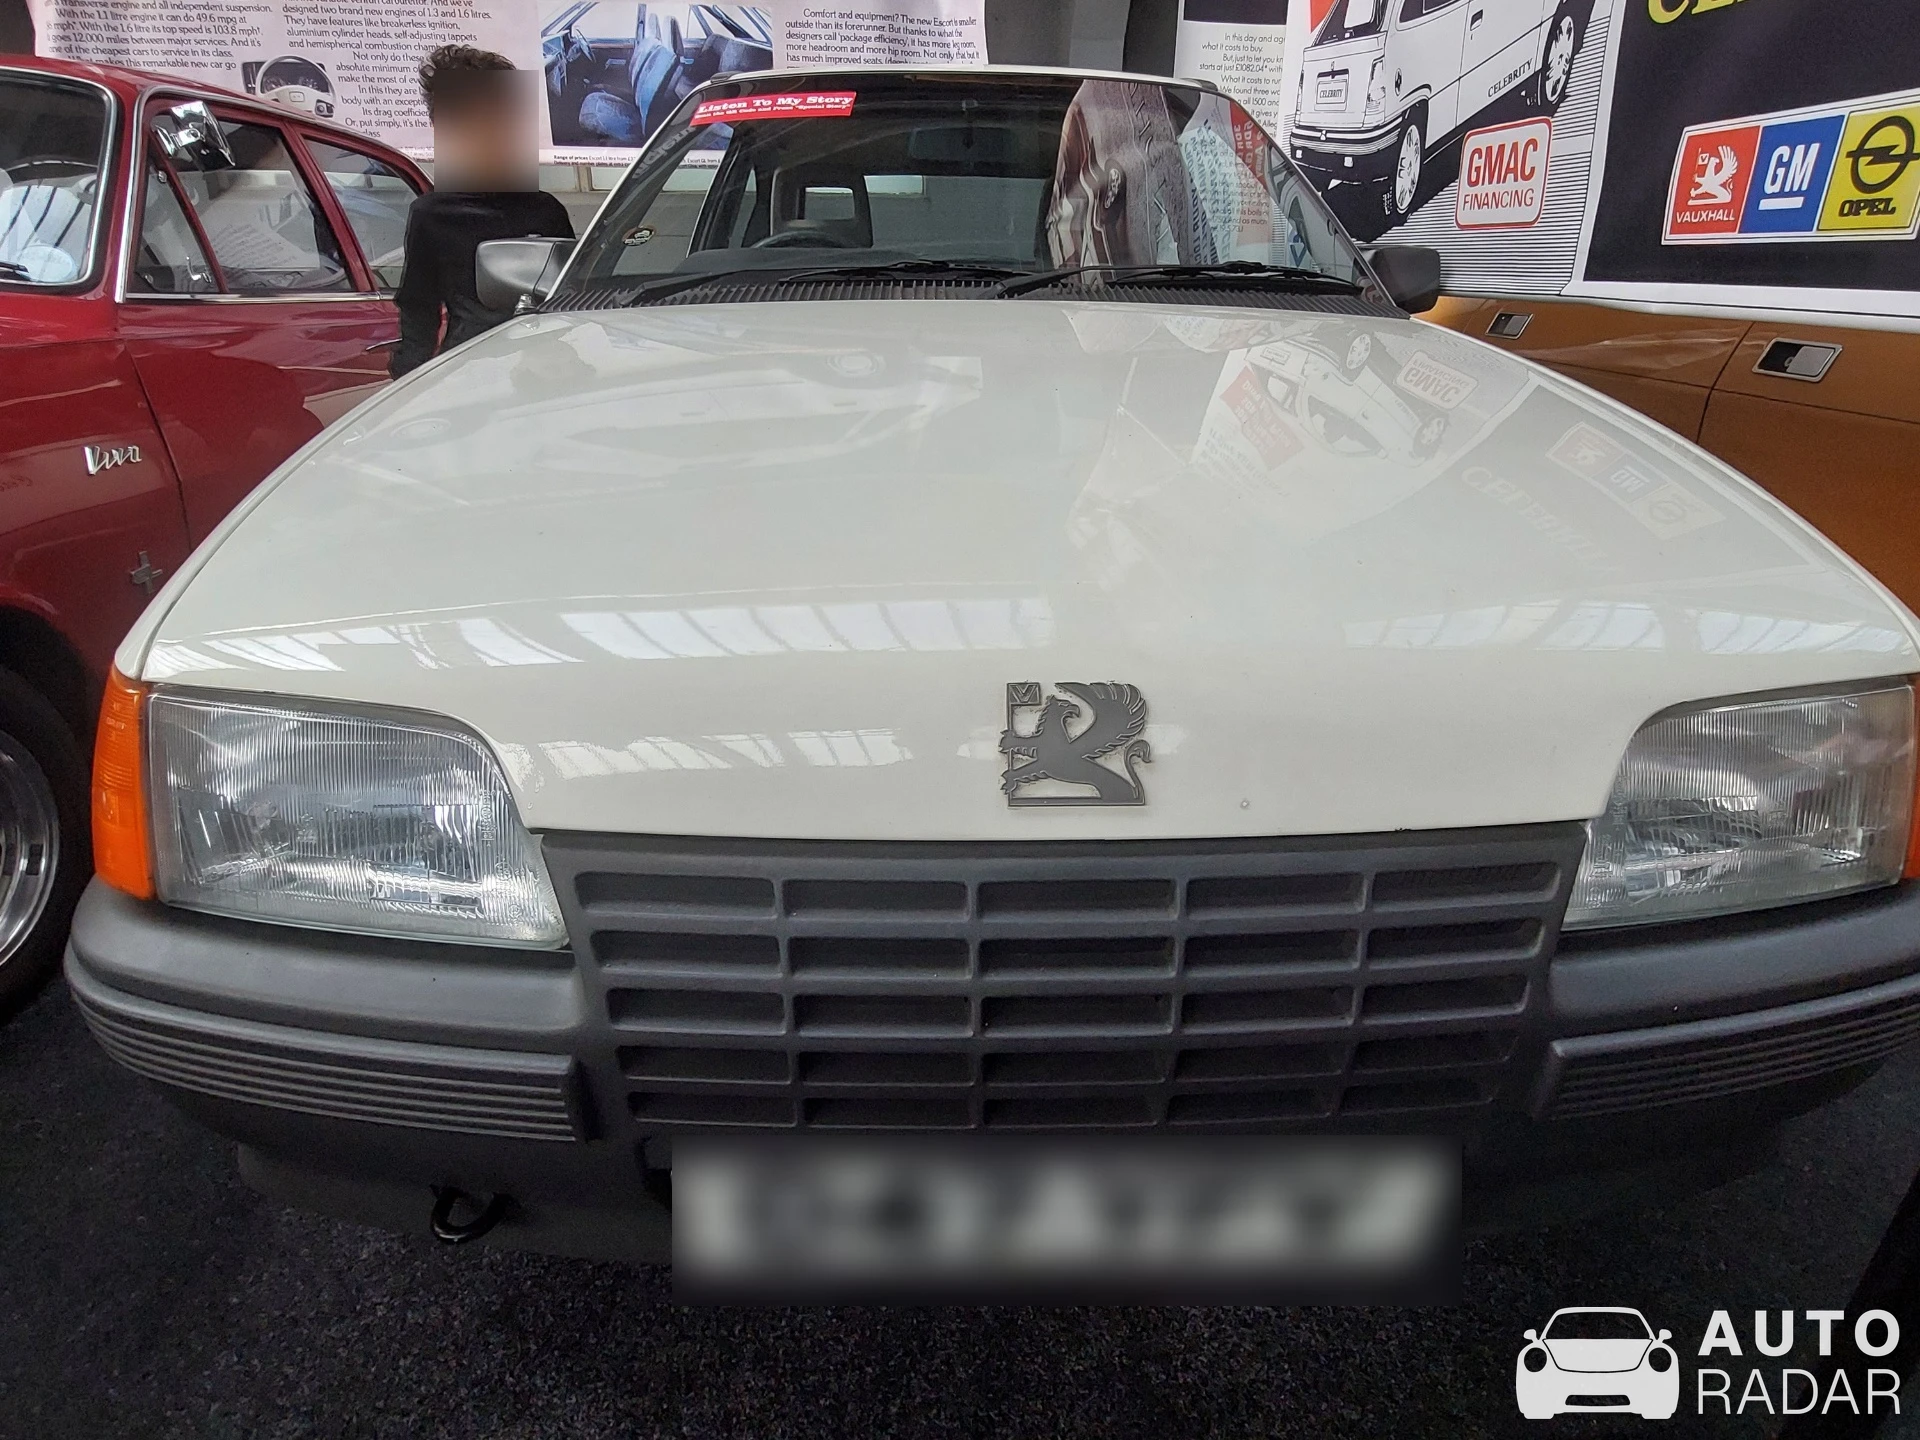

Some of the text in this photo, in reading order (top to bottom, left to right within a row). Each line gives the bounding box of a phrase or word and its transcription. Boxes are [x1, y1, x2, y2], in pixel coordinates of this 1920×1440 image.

[111, 1, 140, 11] engine
[141, 1, 158, 9] and
[170, 1, 223, 12] independent
[225, 4, 272, 13] suspension.
[282, 4, 318, 15] designed
[320, 6, 337, 14] two
[339, 6, 363, 15] brand
[385, 8, 416, 18] engines
[427, 8, 439, 17] 1.3
[440, 9, 456, 18] and
[458, 9, 469, 18] 1.6
[471, 9, 492, 19] litres.
[55, 8, 79, 19] With
[80, 10, 95, 19] the
[110, 10, 127, 20] litre
[130, 13, 156, 23] engine
[183, 13, 194, 22] do
[196, 13, 216, 22] 49.6
[217, 16, 237, 25] mpg
[284, 15, 460, 30] They have features like breakerless ignition,
[803, 8, 837, 19] Comfort
[838, 10, 853, 19] and
[855, 12, 899, 22] equipment?
[900, 14, 915, 24] The
[933, 17, 953, 27] Escort
[80, 22, 237, 35] With the 1.6 litre top speed 103.8
[287, 27, 330, 37] aluminium
[331, 28, 364, 39] cylinder
[394, 30, 446, 42] self-adjusting
[448, 32, 477, 42] tappets
[785, 20, 954, 38] outside than forerunner. But thanks what
[52, 33, 249, 47] goes 12,000 miles between major services. And
[785, 30, 951, 49] designers call has more
[1232, 32, 1273, 44] this day and
[289, 39, 412, 50] and hemispherical combustion
[1202, 42, 1263, 54] what costs buy.
[75, 45, 234, 57] the cheapest cars service class.
[352, 51, 369, 61] Not
[371, 52, 389, 62] only
[390, 52, 401, 61] do
[403, 53, 425, 62] these
[808, 42, 848, 52] headroom
[850, 44, 864, 53] and
[888, 46, 899, 57] hip
[923, 49, 937, 58] Not
[938, 51, 955, 61] only
[125, 59, 141, 67] this
[143, 59, 189, 68] remarkable
[210, 61, 223, 69] car
[786, 52, 861, 65] has much improved
[1263, 57, 1275, 65] you
[336, 62, 411, 73] absolute minimum
[1199, 63, 1215, 71] starts
[1224, 64, 1234, 72] just
[1269, 65, 1282, 73] with
[338, 73, 397, 84] make the most
[1220, 74, 1262, 84] What costs
[1487, 58, 1533, 98] CELEBRITY
[369, 85, 384, 95] this
[385, 86, 403, 96] they
[1233, 86, 1252, 95] found
[1253, 87, 1269, 95] three
[1320, 88, 1343, 98] CELEBRITY
[341, 96, 381, 106] body with
[698, 95, 853, 114] Listen To My Story
[1252, 98, 1266, 106] 1500
[362, 107, 393, 118] Its drag
[1256, 109, 1271, 118] gives
[360, 119, 373, 128] put
[414, 119, 428, 128] the
[1466, 137, 1538, 188] GMAC
[1764, 142, 1820, 195] GM
[1462, 187, 1535, 212] FINANCING
[1838, 197, 1896, 217] OPEL
[1676, 208, 1735, 223] VAUXHALL
[84, 444, 142, 476] Viva
